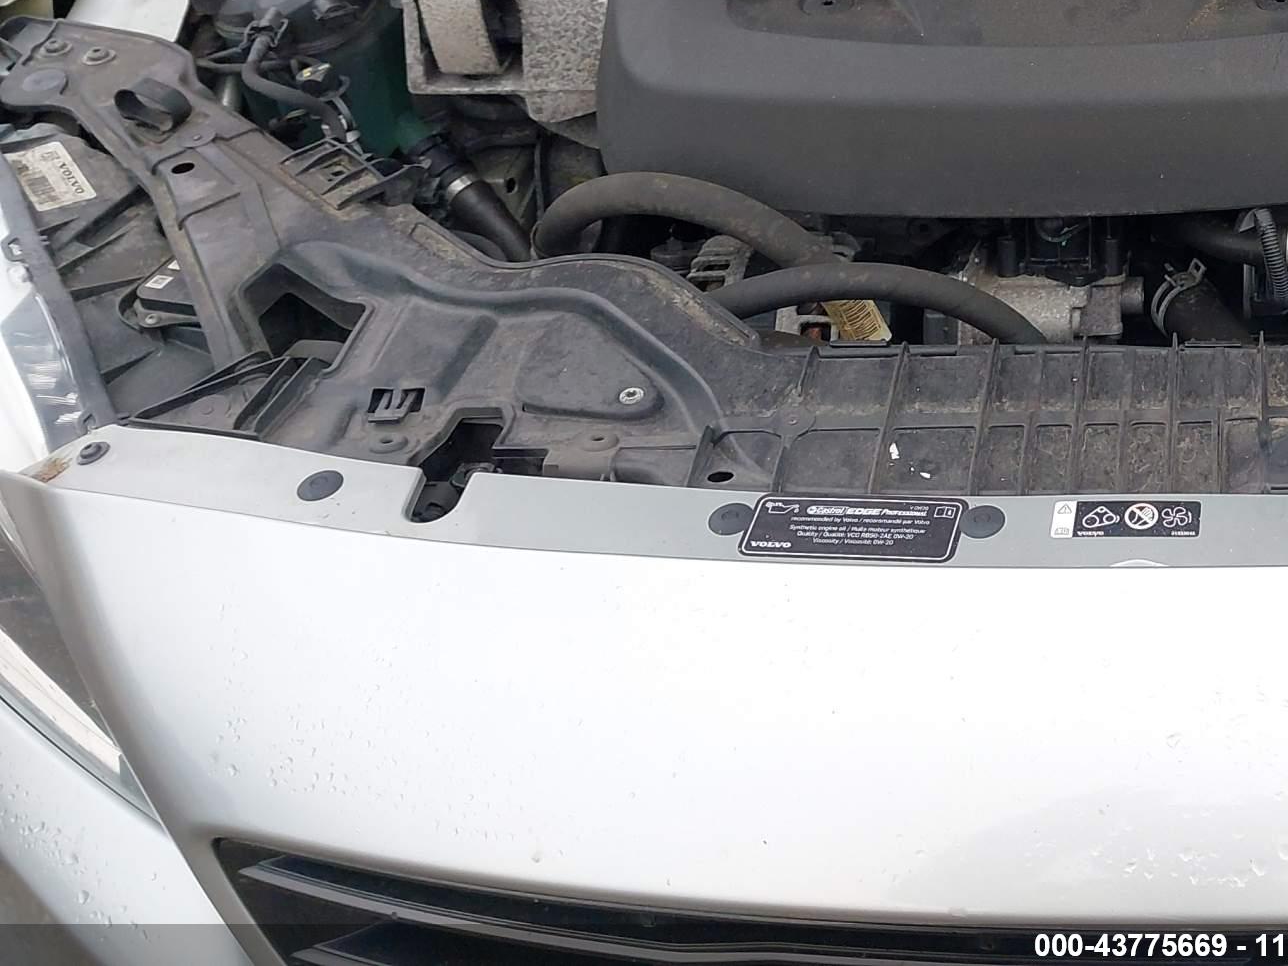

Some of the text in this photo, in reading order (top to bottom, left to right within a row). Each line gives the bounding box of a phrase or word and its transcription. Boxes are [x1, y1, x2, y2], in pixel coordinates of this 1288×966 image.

[59, 162, 84, 194] VOLVO
[816, 505, 843, 515] Castrol
[846, 507, 882, 516] EDGE
